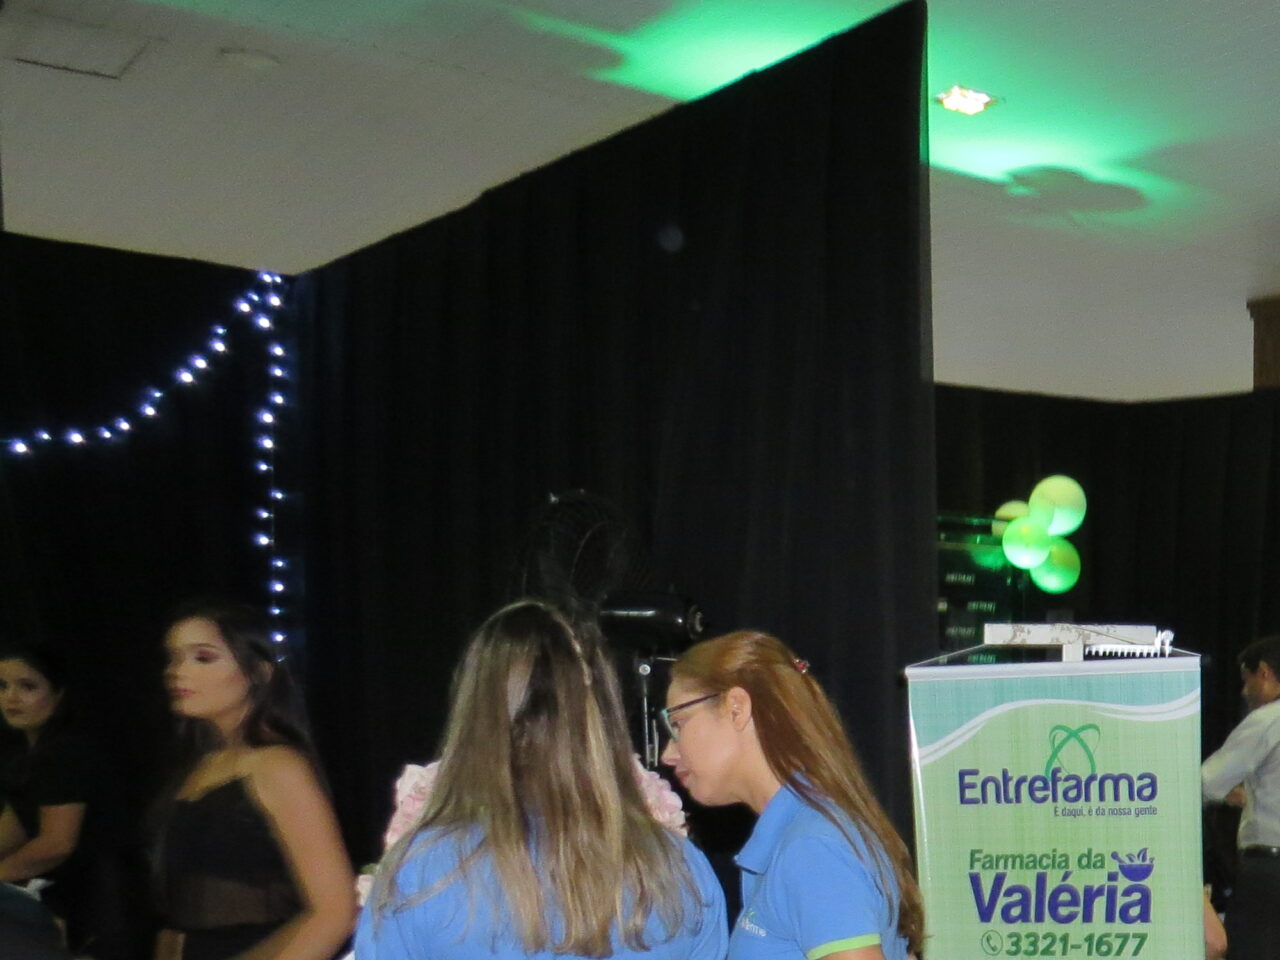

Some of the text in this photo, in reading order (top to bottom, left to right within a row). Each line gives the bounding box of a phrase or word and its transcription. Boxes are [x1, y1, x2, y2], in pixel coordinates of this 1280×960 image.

[958, 767, 1158, 804] Entrefarma
[1096, 806, 1106, 816] da
[1108, 807, 1132, 816] nossa
[1135, 806, 1157, 818] gente
[969, 848, 1106, 870] Farmacia da
[969, 871, 1152, 924] Valéria
[1005, 932, 1148, 957] 3321-1677
